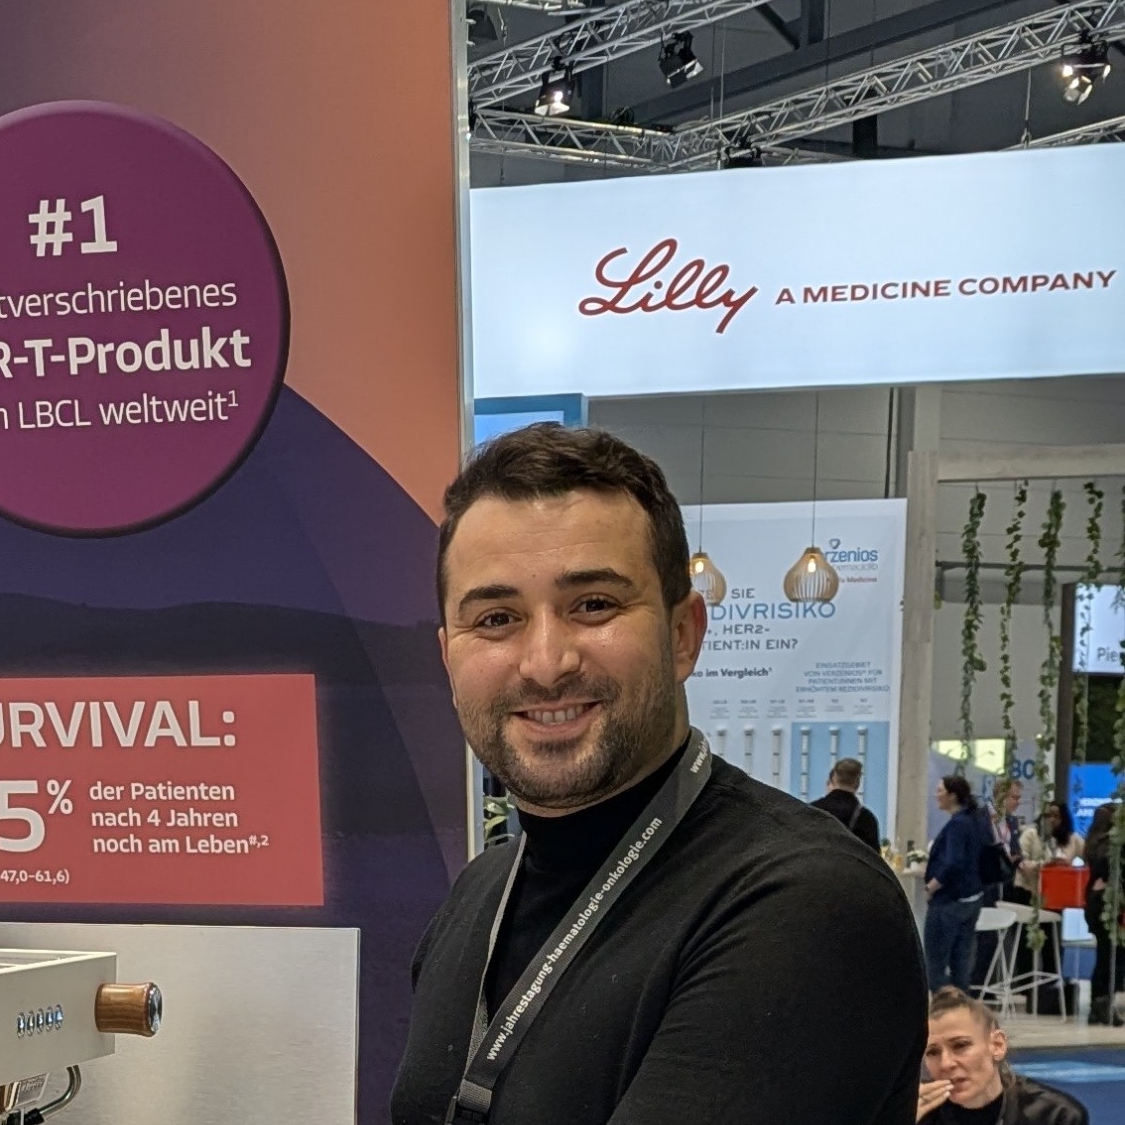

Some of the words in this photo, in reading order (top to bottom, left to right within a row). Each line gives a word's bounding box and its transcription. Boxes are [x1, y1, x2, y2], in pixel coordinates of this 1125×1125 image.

[28, 195, 118, 257] #1
[578, 238, 759, 334] Lilly
[775, 286, 795, 305] A
[803, 280, 951, 304] MEDICINE
[958, 270, 1118, 296] COMPANY
[19, 398, 91, 429] LBCL
[731, 588, 755, 599] SIE
[723, 624, 770, 635] HER2-
[766, 638, 798, 650] EIN?
[89, 782, 124, 801] der
[131, 781, 235, 801] Patienten
[91, 809, 142, 827] nach
[147, 810, 161, 827] 4
[166, 808, 238, 827] Jahren
[93, 834, 144, 853] noch
[149, 838, 179, 854] am
[486, 817, 663, 1062] www.jahrestagung-haematologie-onkologie.com
